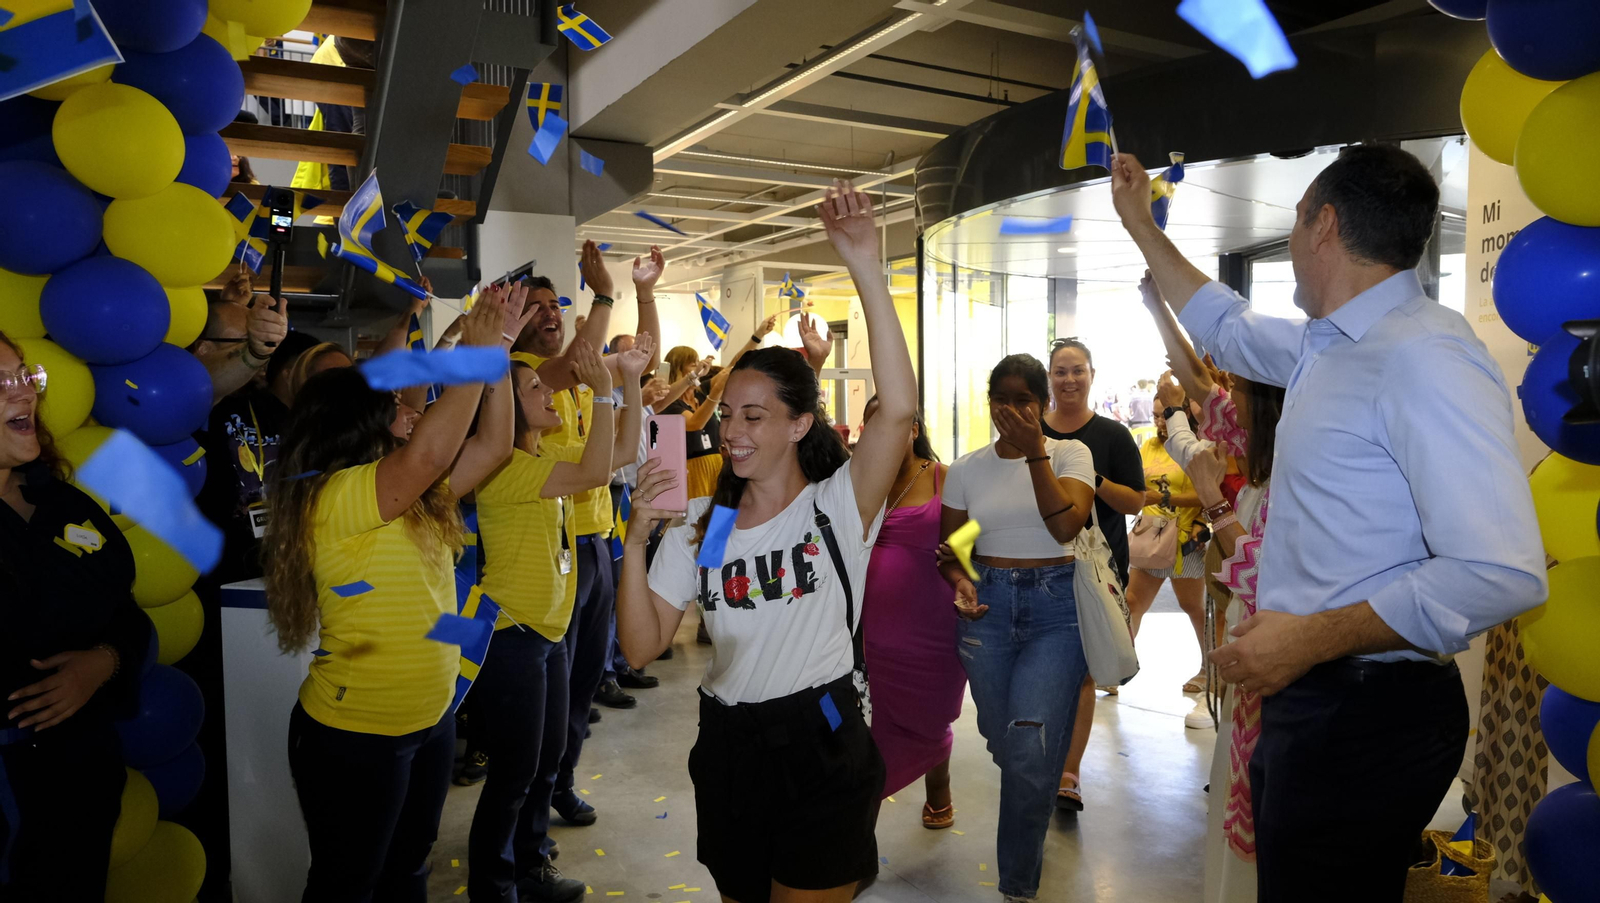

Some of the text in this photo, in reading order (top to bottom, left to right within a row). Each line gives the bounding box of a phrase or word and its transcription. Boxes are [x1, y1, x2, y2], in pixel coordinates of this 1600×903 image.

[1482, 199, 1501, 225] Mi
[1479, 297, 1488, 308] La
[698, 542, 818, 612] LOVE
